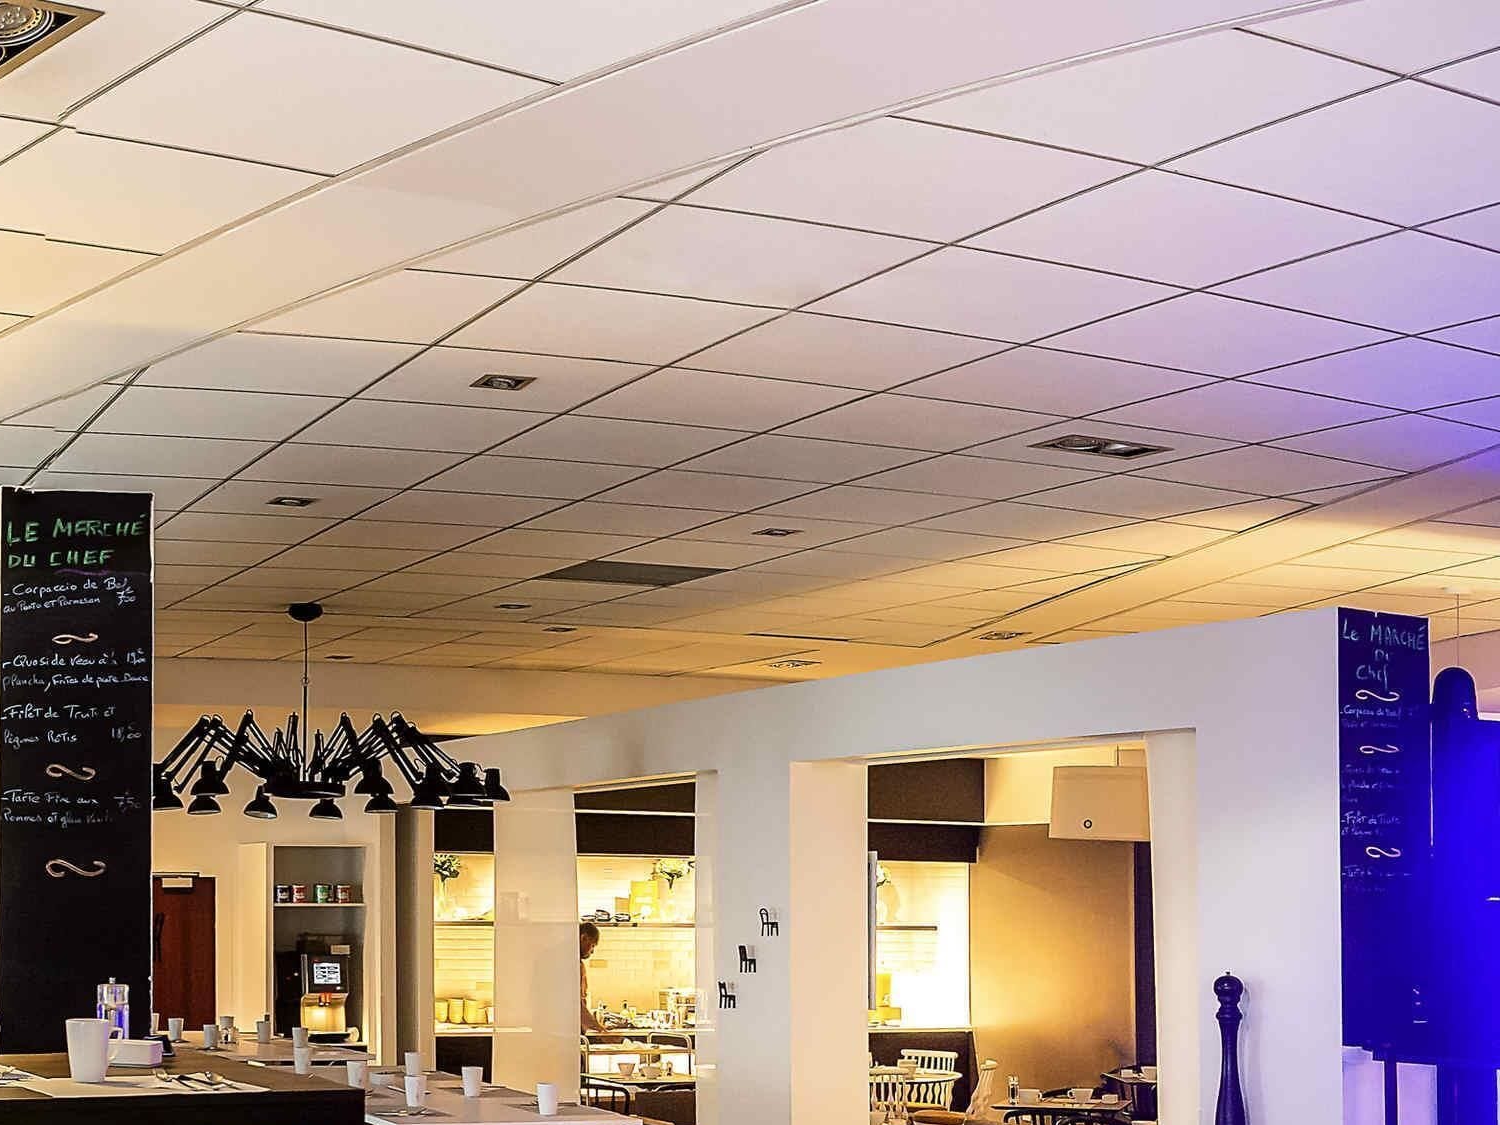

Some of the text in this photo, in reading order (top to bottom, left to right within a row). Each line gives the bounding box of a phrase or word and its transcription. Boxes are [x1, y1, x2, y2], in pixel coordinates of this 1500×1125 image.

[7, 521, 40, 546] LE
[8, 549, 115, 568] DU CHEF
[83, 578, 98, 590] de
[1370, 624, 1426, 650] MARCHÉ
[52, 653, 67, 666] de
[81, 674, 94, 684] de
[1356, 664, 1388, 692] Chef
[44, 706, 60, 718] de
